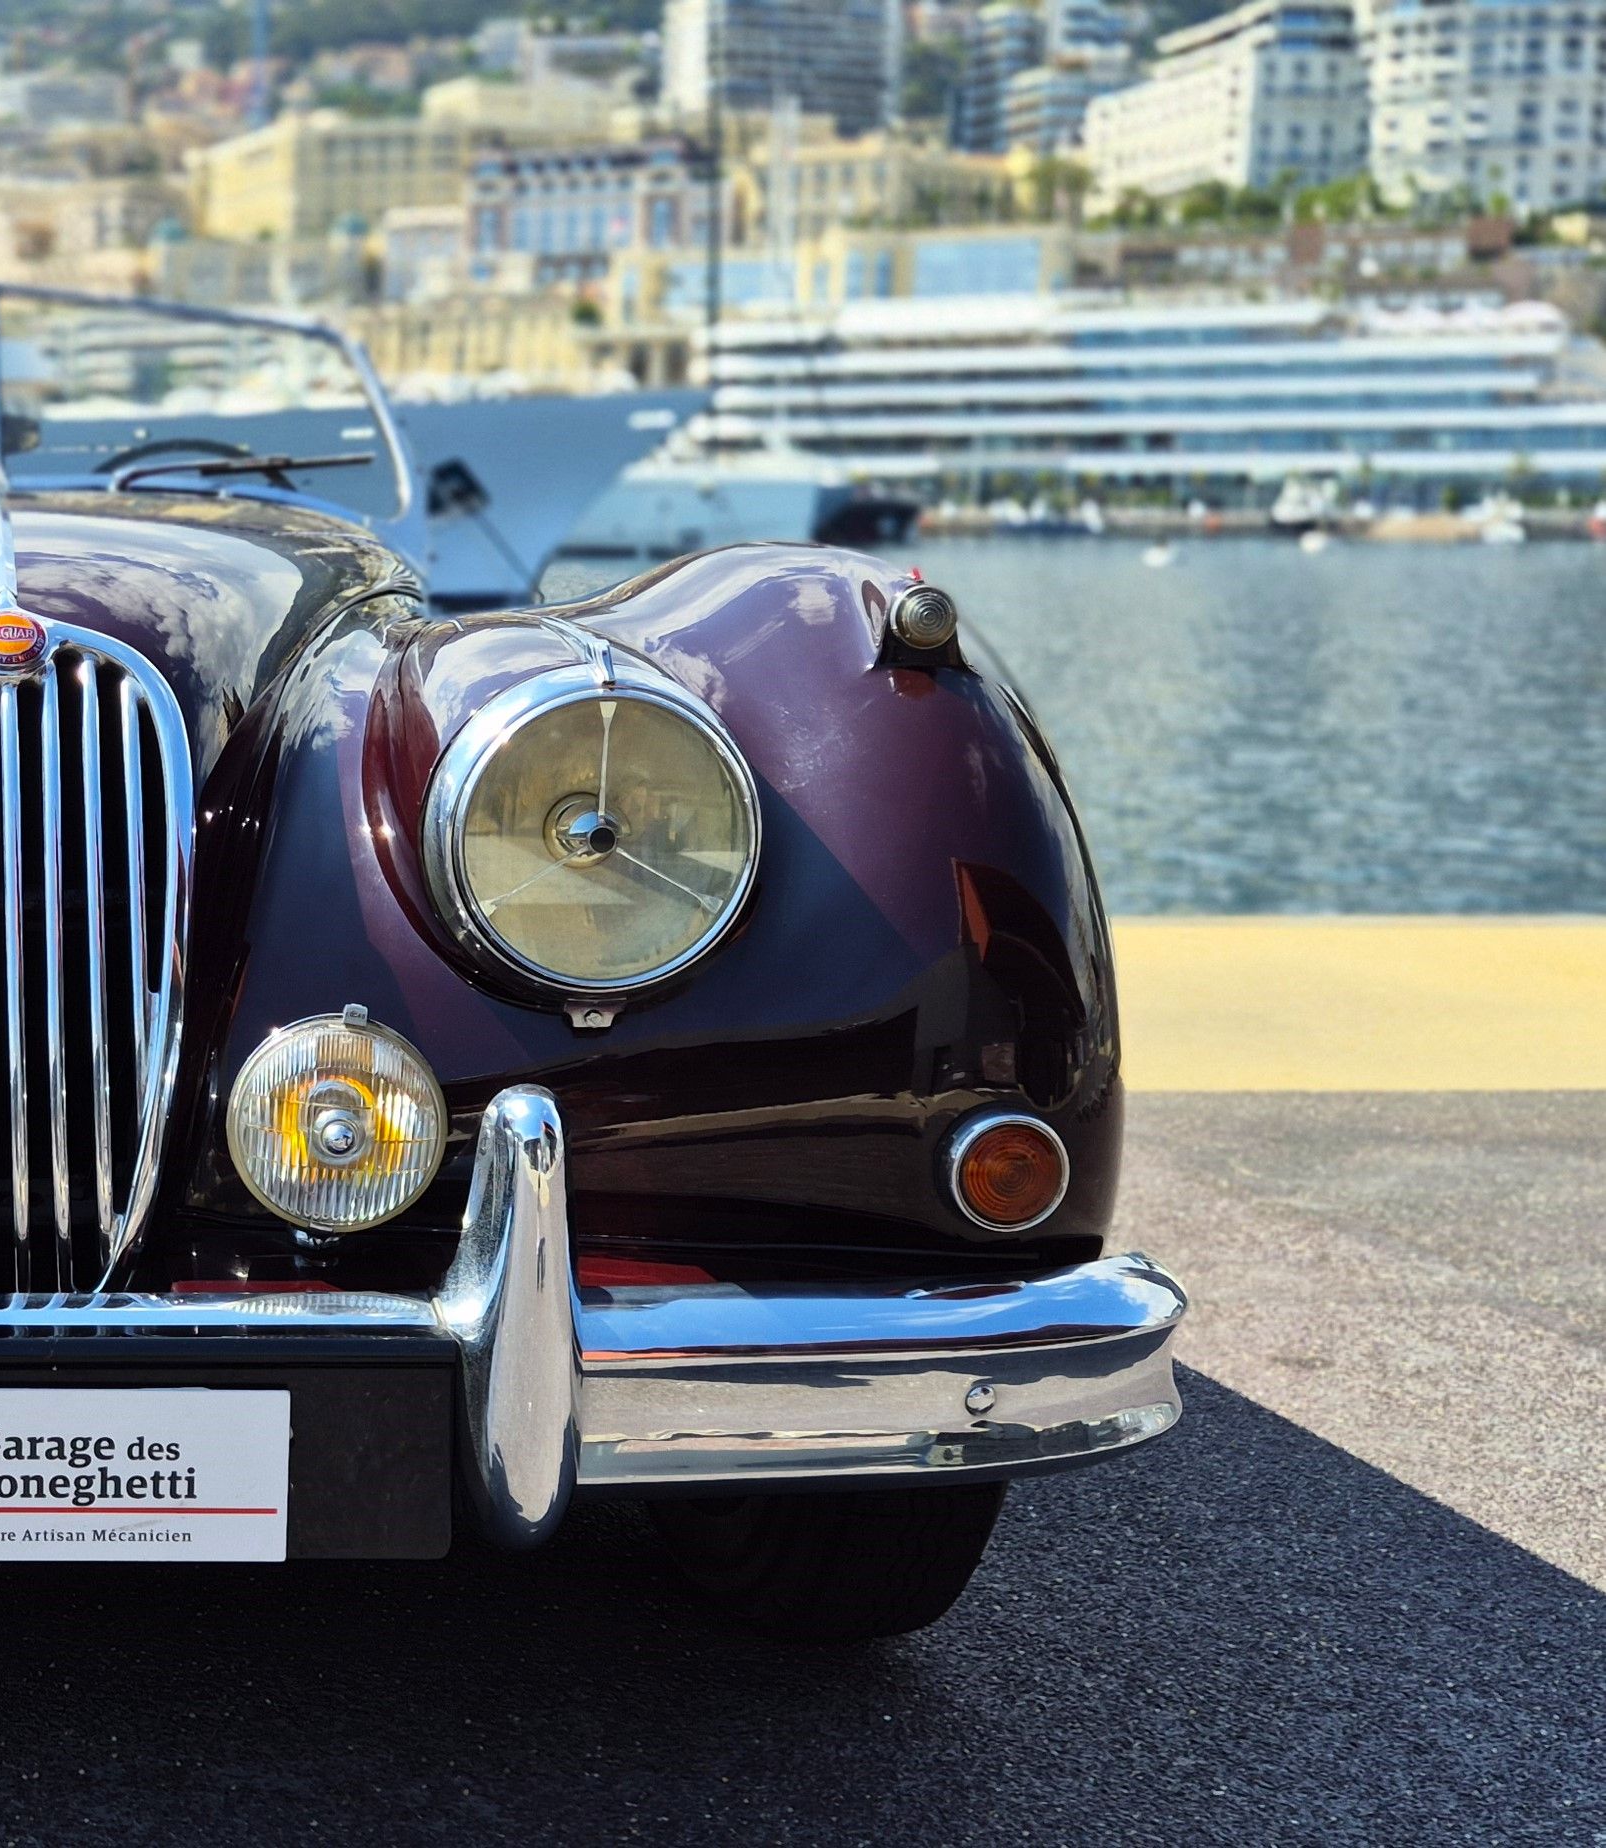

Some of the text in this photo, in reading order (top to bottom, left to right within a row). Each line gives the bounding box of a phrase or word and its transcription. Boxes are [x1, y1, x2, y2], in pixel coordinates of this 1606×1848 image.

[126, 1436, 181, 1461] des
[21, 1528, 86, 1543] Artisan
[91, 1527, 192, 1543] Mécanicien
